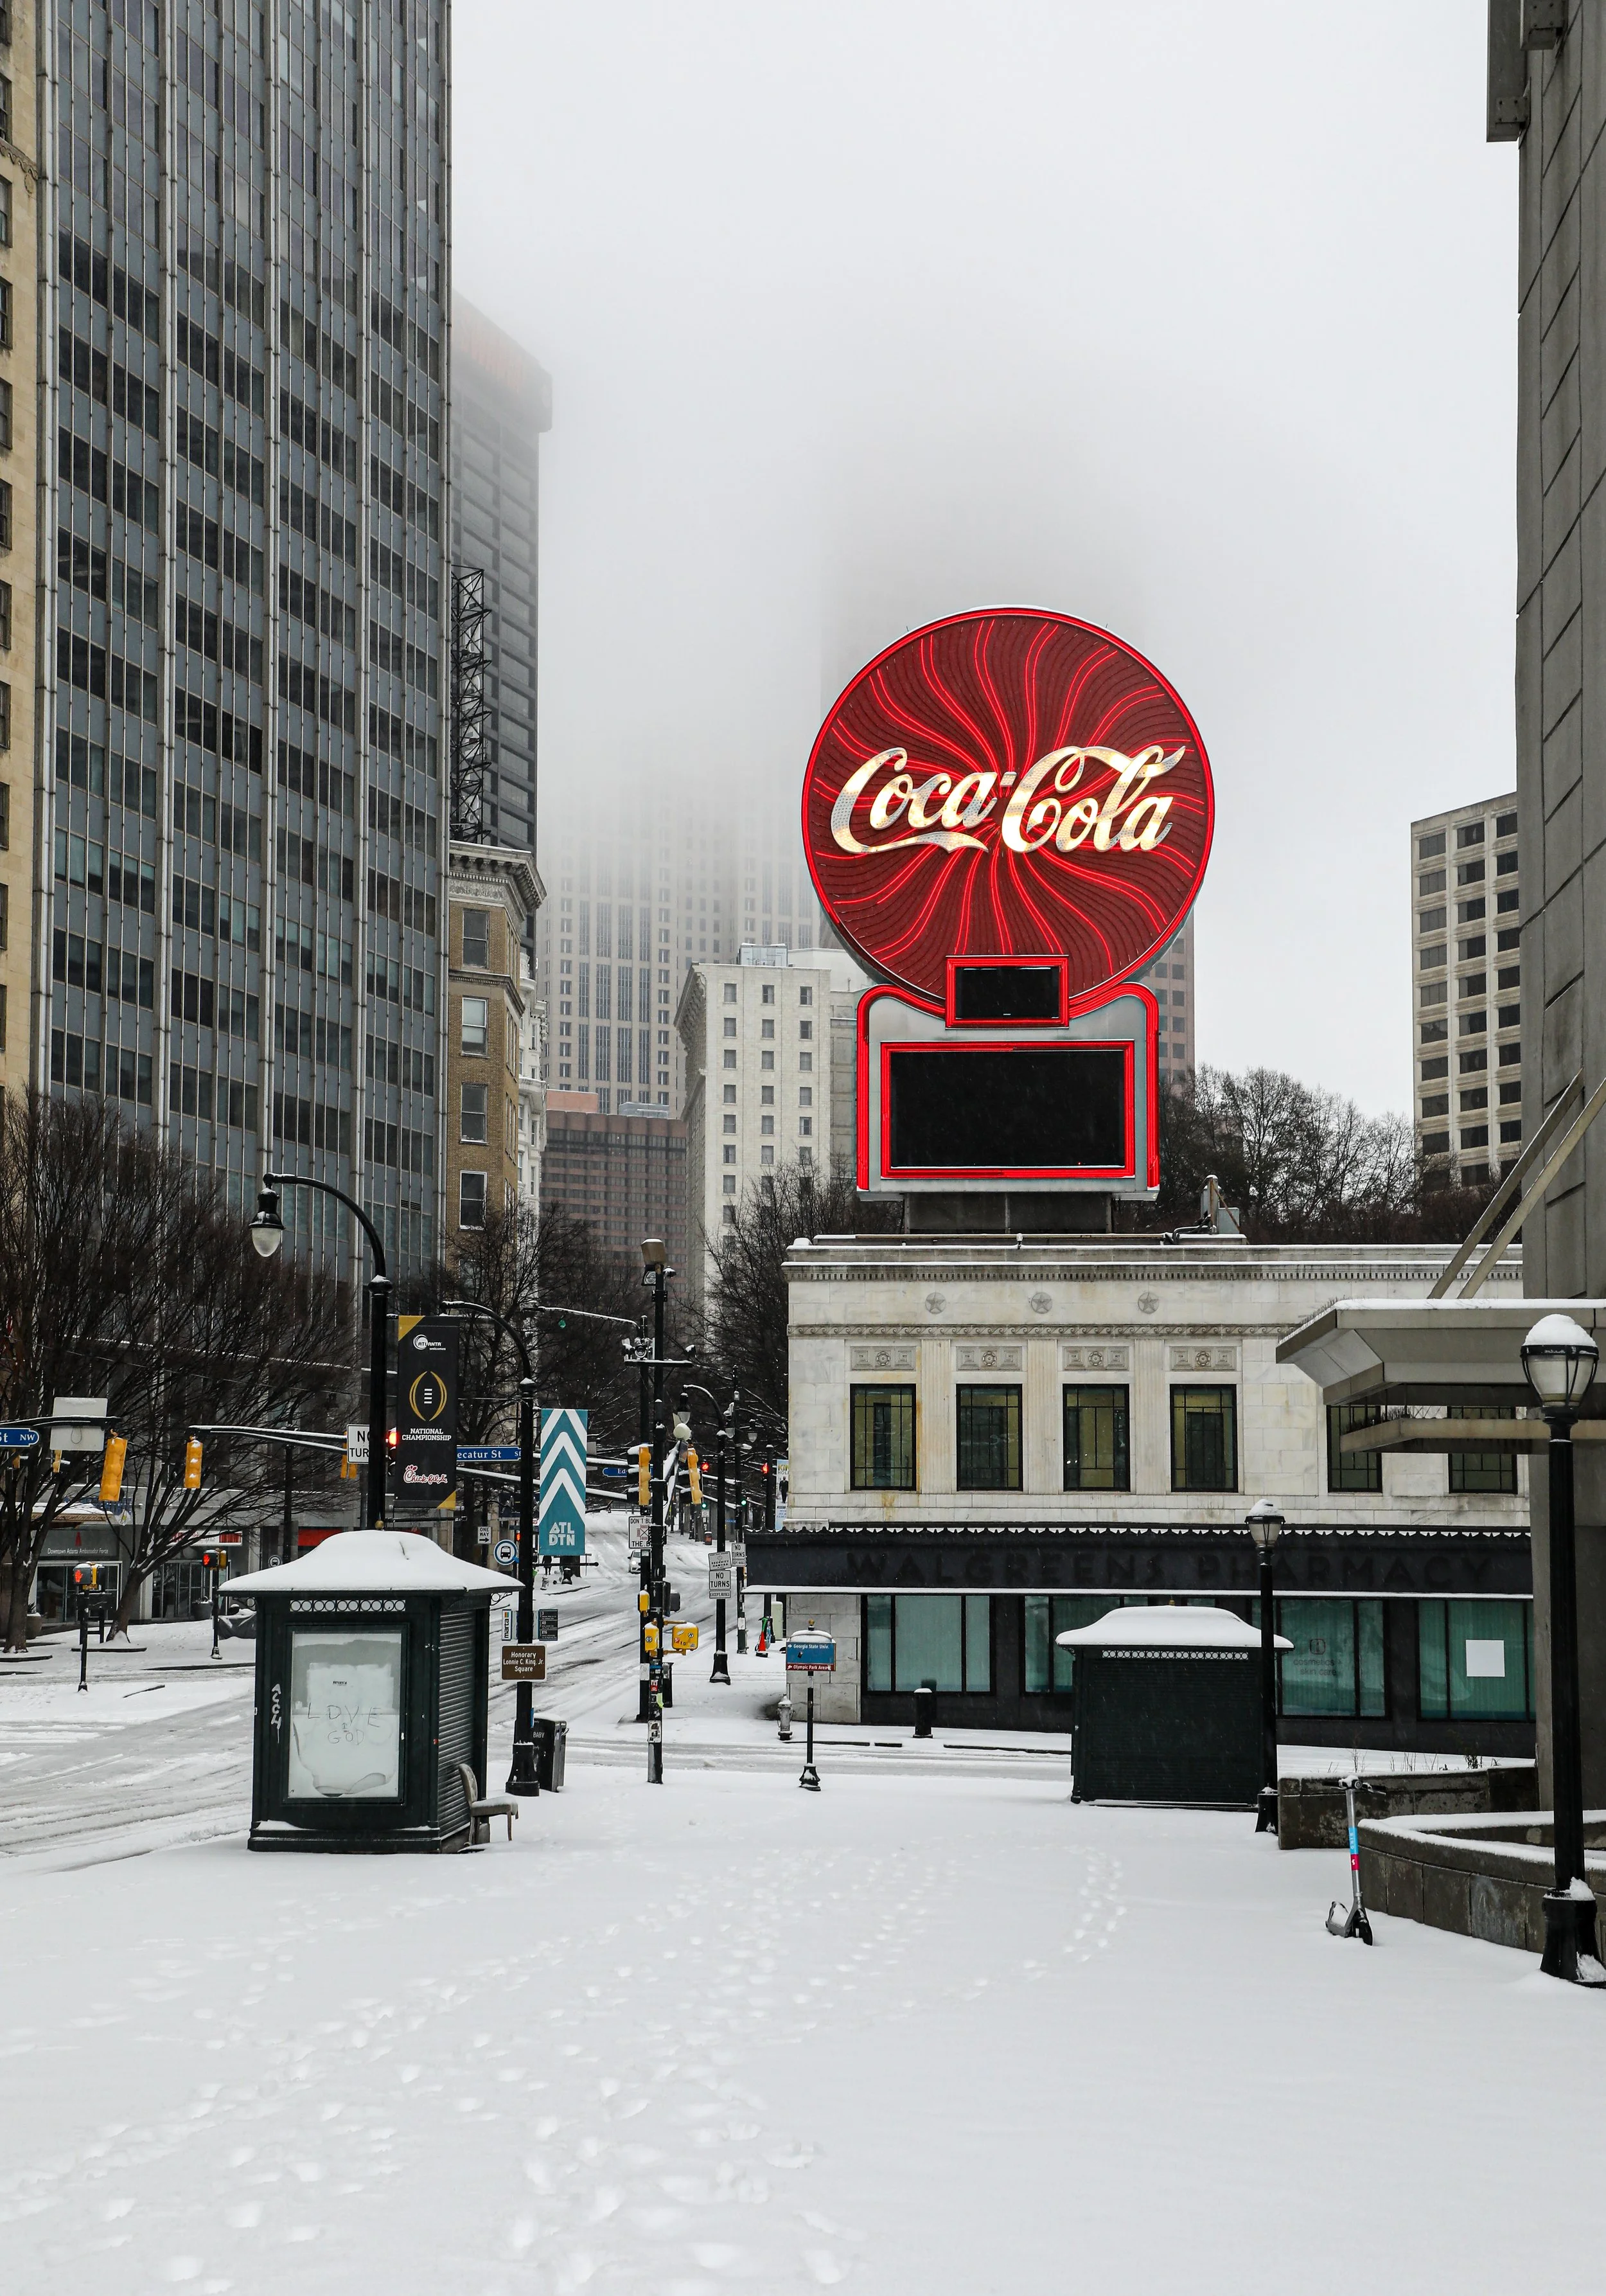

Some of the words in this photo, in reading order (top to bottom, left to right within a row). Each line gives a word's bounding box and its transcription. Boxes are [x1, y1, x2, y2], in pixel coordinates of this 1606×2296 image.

[831, 745, 1187, 853] Coca-Cola
[349, 1448, 369, 1457] TUR
[457, 1450, 488, 1459] ecatur
[491, 1450, 502, 1458] St
[549, 1522, 575, 1534] ATL
[549, 1534, 576, 1546] DTN
[846, 1552, 1165, 1585] WALGREENS
[1197, 1554, 1493, 1589] PHARMACY
[514, 1666, 533, 1674] Square
[327, 1729, 364, 1746] GOD
